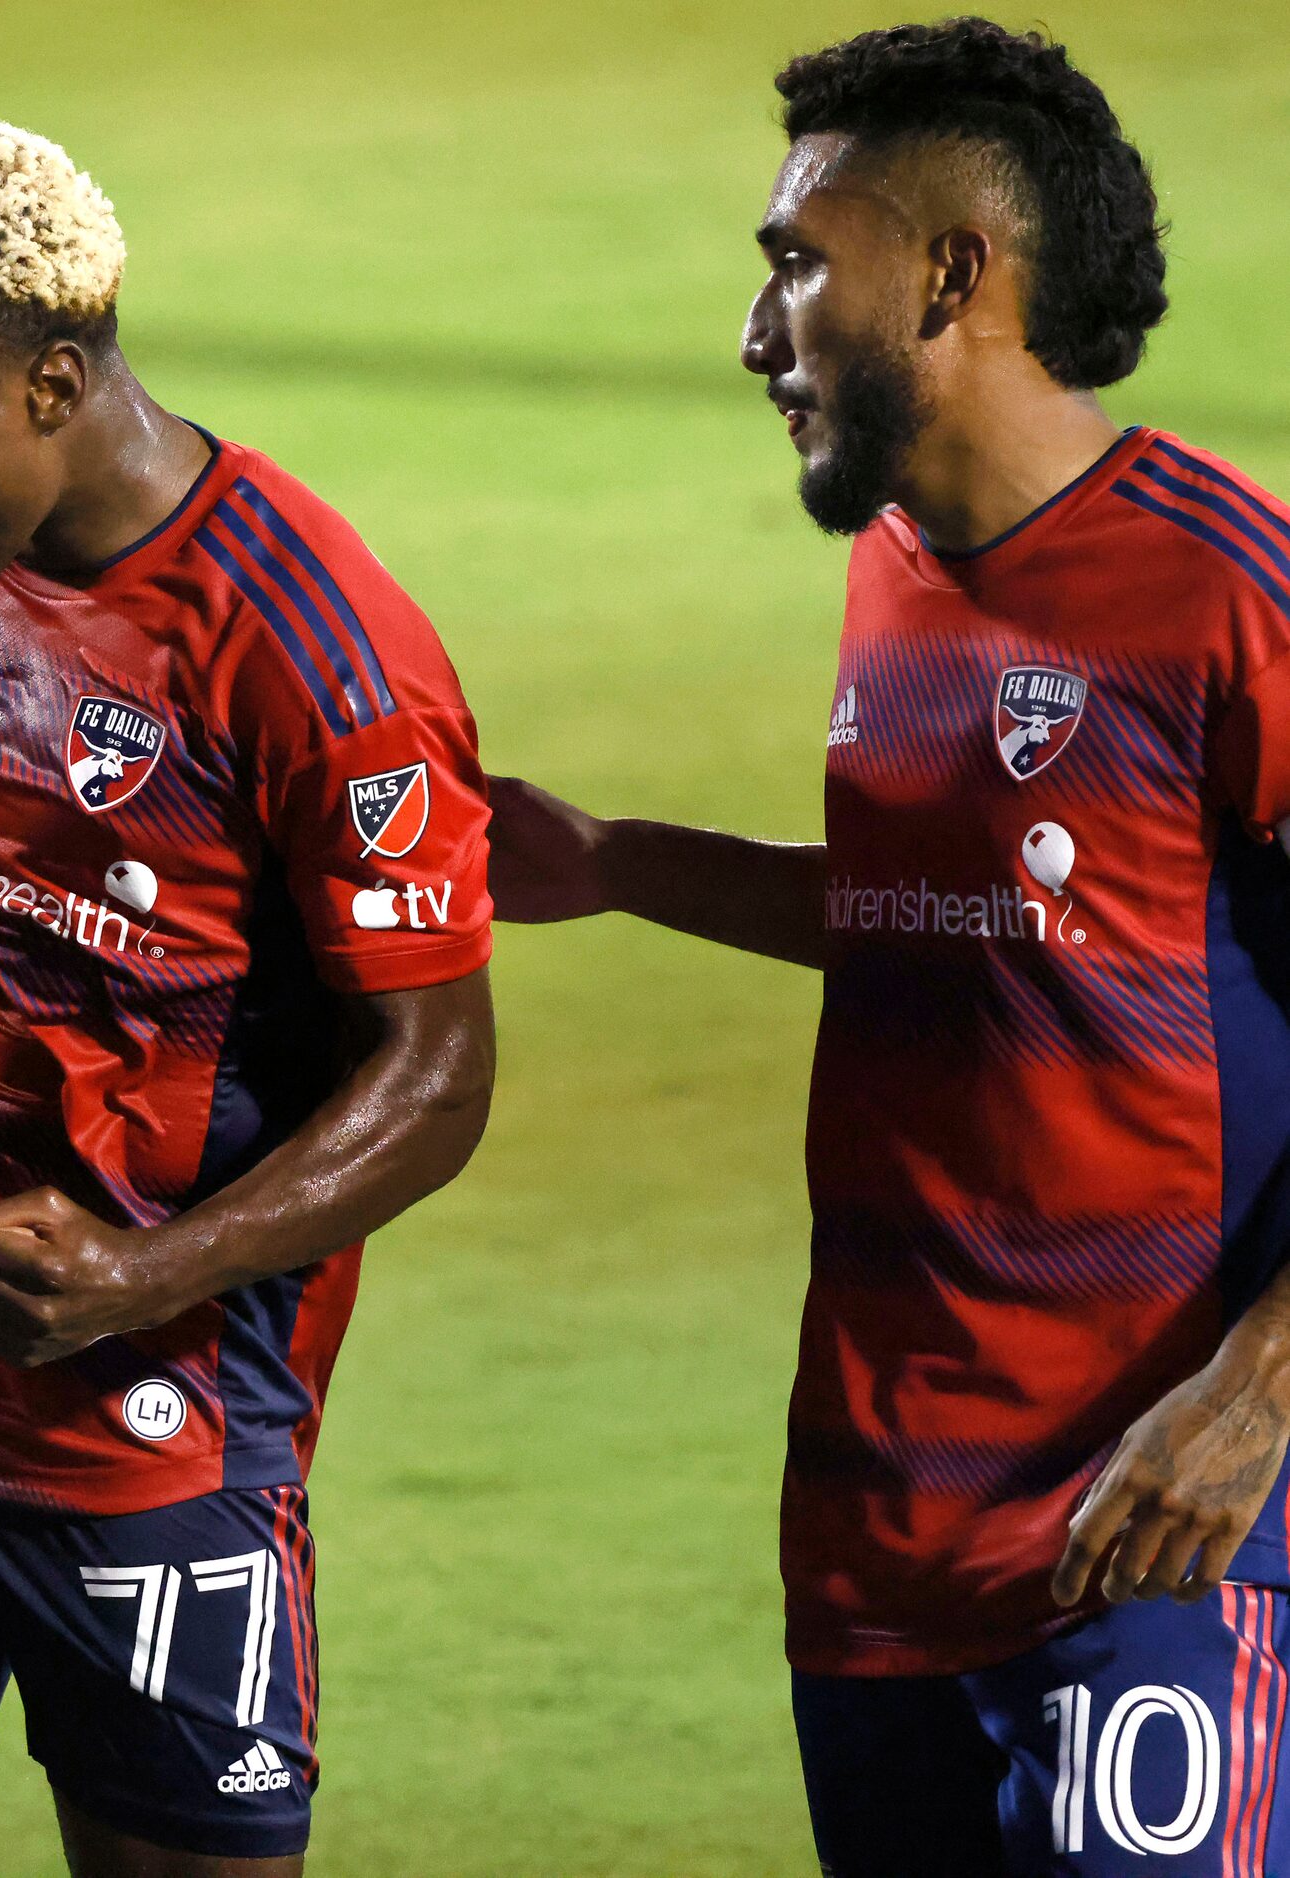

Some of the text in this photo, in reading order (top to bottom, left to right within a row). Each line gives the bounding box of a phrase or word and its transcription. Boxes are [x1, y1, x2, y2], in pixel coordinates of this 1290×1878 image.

[1005, 675, 1079, 708] FC DALLAS
[80, 703, 158, 750] FC DALLAS
[106, 737, 123, 747] 96
[356, 778, 399, 804] MLS
[402, 879, 452, 929] tv
[824, 874, 1046, 942] hildren'shealth
[137, 1396, 172, 1425] LH
[78, 1547, 279, 1728] 77
[217, 1768, 291, 1794] adidas
[1042, 1683, 1221, 1856] 10
